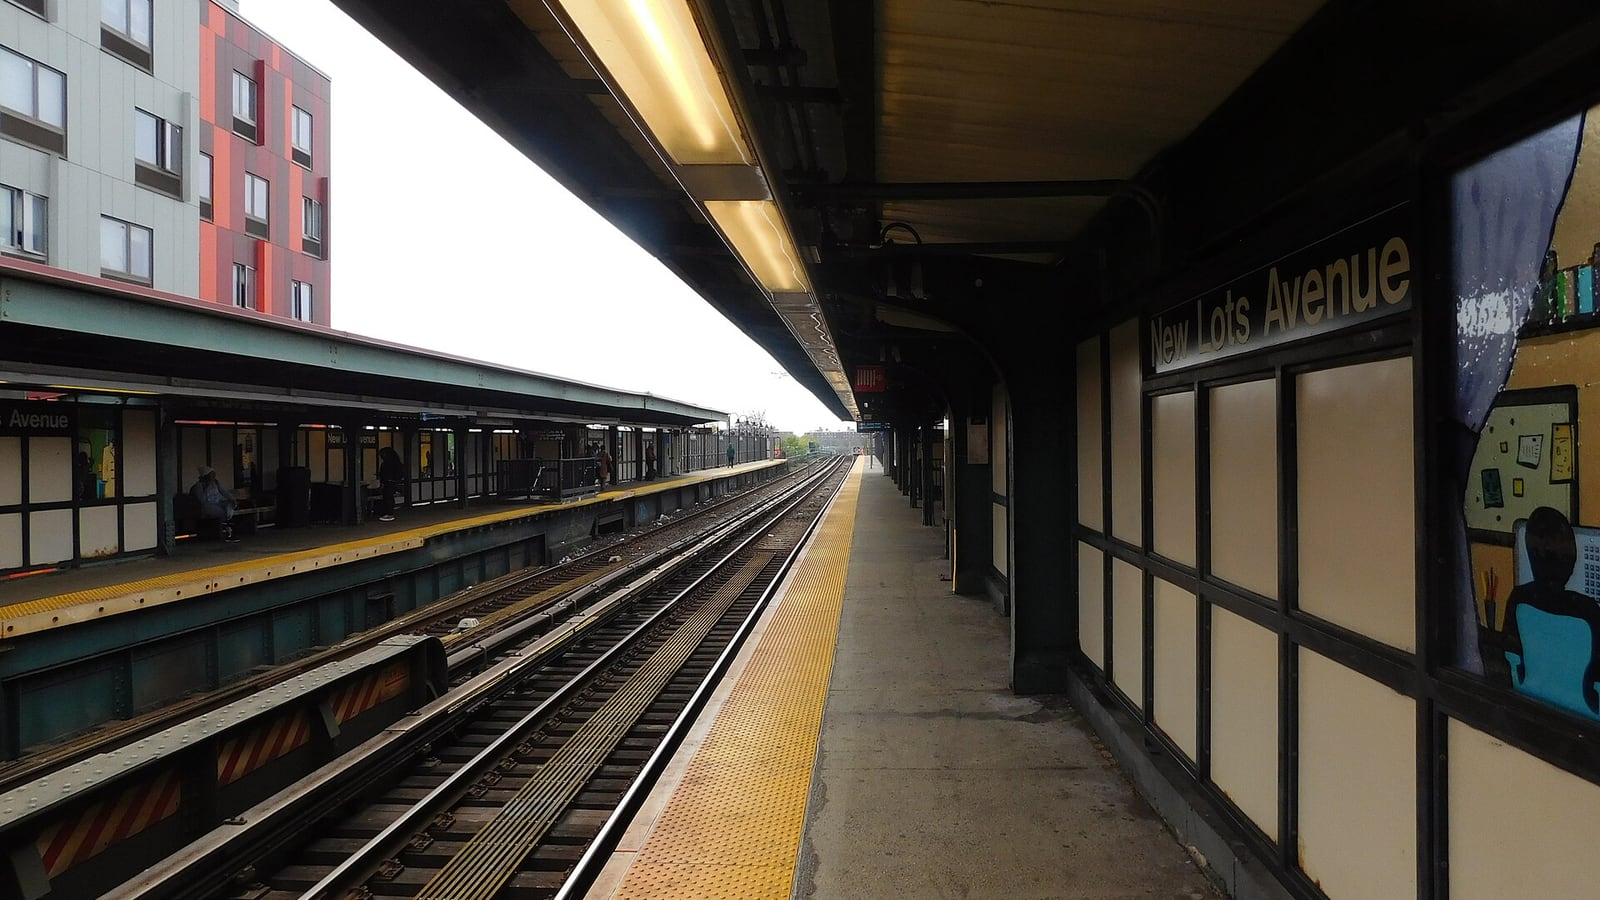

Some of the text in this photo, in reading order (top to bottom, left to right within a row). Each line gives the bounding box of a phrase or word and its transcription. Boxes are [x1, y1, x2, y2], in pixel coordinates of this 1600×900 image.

[1150, 236, 1411, 368] New Lots Avenue
[9, 408, 69, 428] Avenue
[327, 432, 341, 444] New
